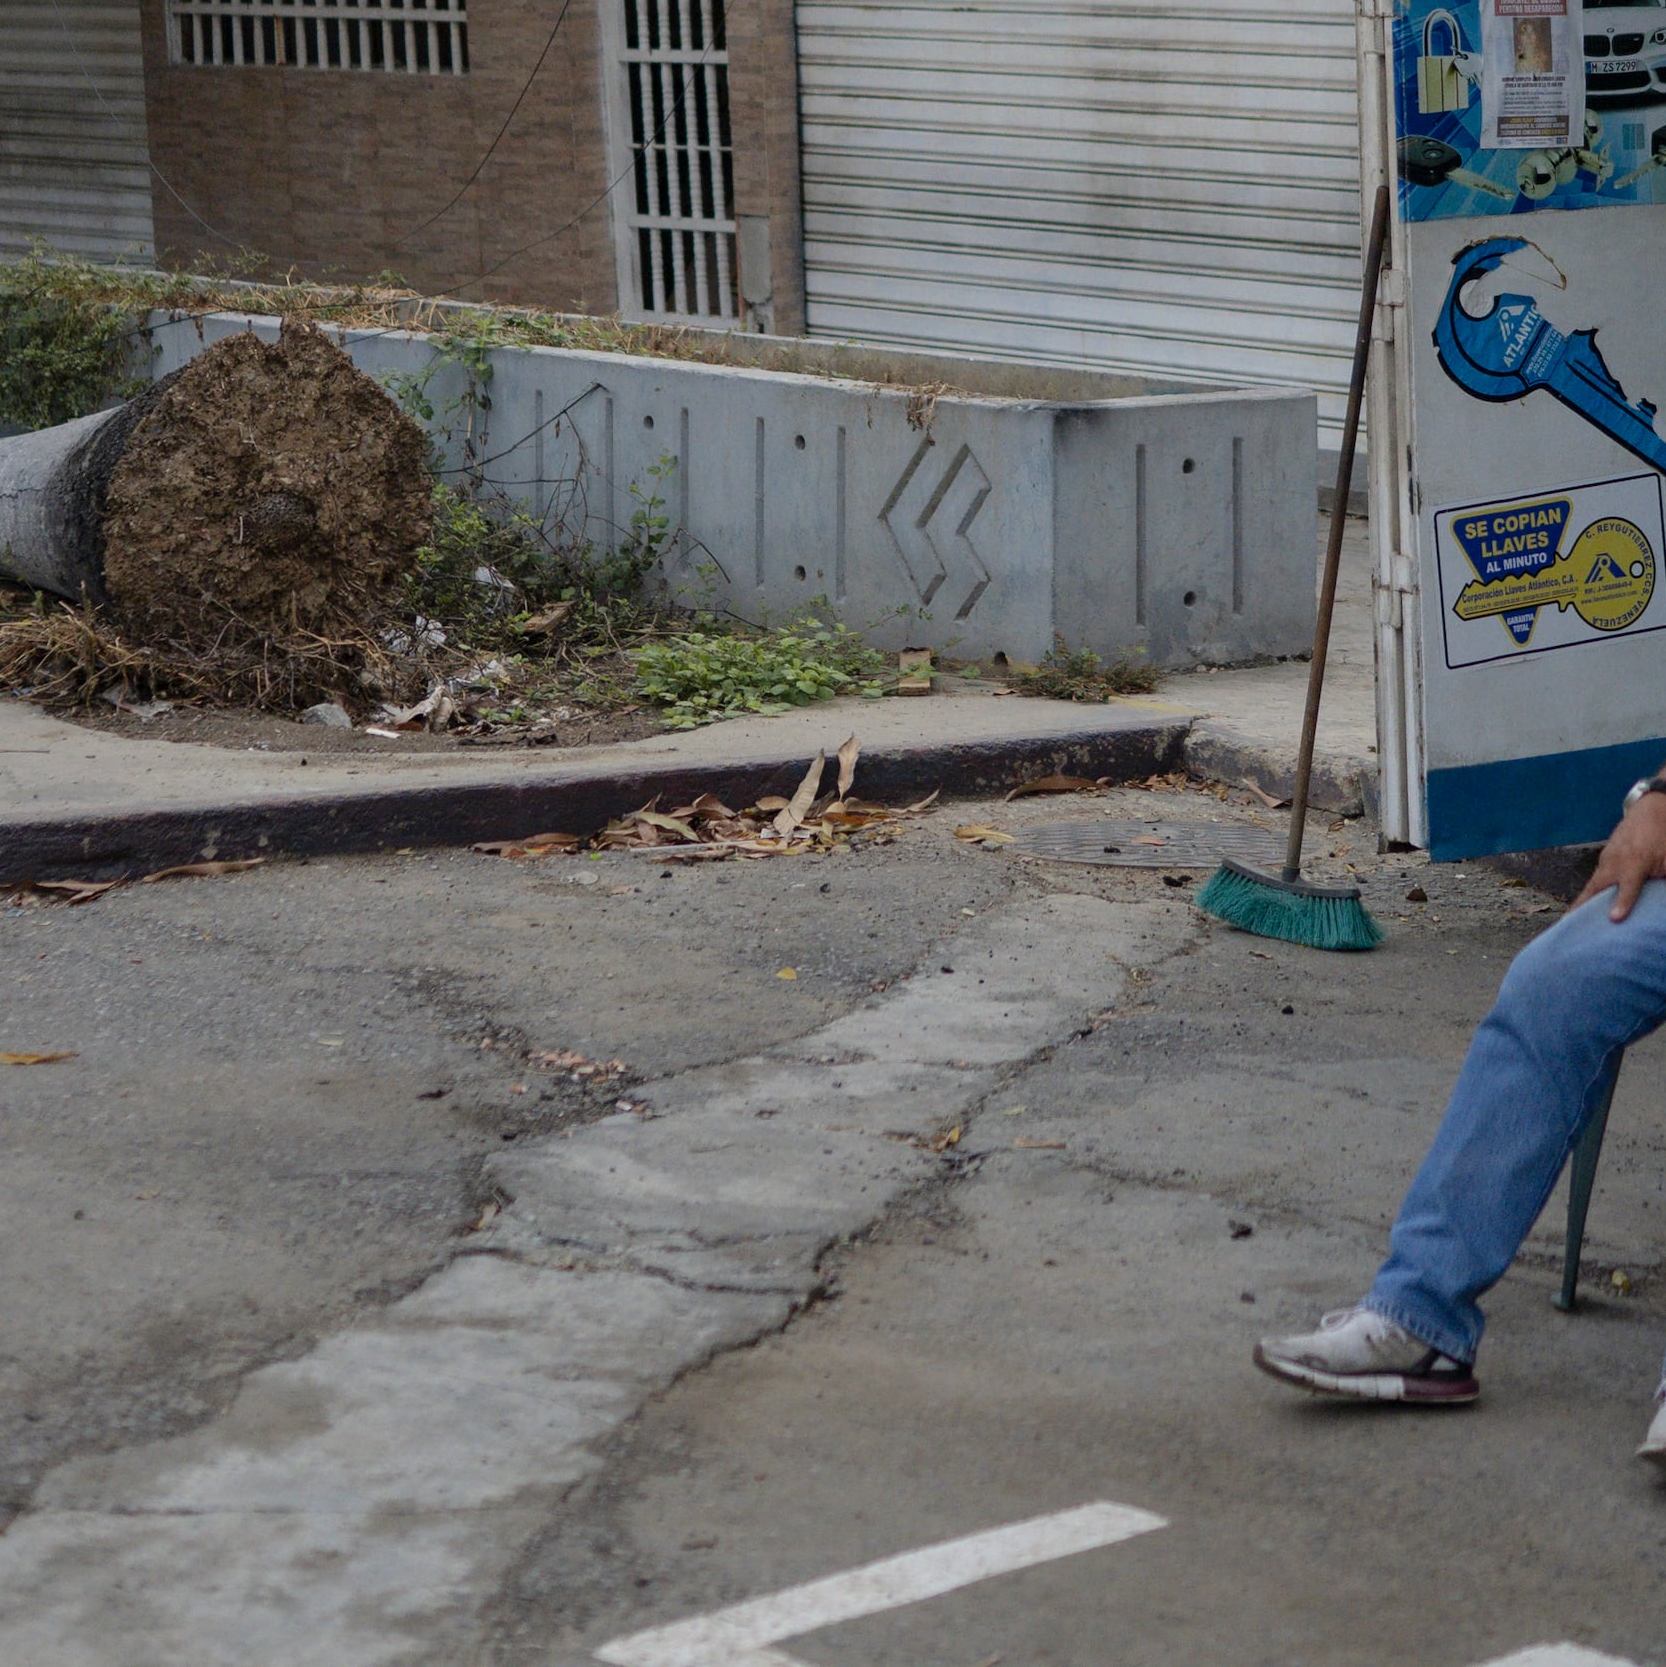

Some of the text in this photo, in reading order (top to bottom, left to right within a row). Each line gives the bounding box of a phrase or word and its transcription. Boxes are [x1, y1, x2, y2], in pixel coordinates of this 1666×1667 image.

[1591, 63, 1598, 72] M
[1464, 507, 1562, 539] SE COPIAN
[1480, 530, 1549, 558] LLAVES
[1486, 552, 1548, 574] AL MINUTO
[1505, 582, 1528, 596] Llaves
[1592, 599, 1644, 628] VENEZUELA
[1513, 623, 1530, 633] TOTAL
